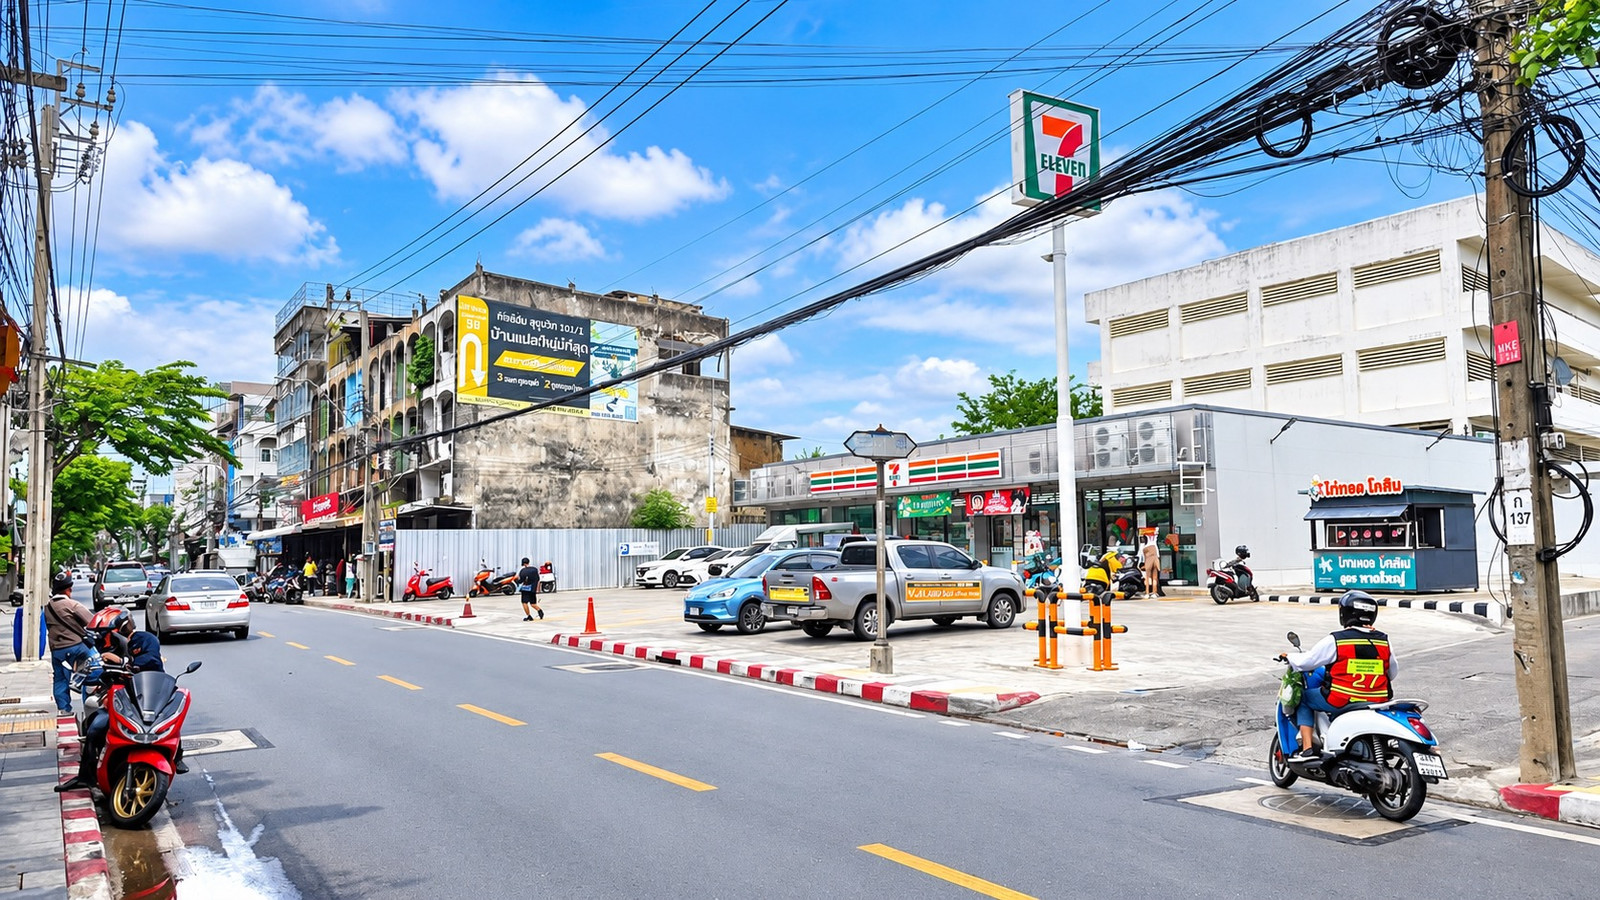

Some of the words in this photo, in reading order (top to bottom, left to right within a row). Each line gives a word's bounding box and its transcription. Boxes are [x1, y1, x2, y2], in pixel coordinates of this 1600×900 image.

[1042, 114, 1083, 199] 7
[1510, 511, 1531, 525] 137
[1352, 672, 1379, 689] 27
